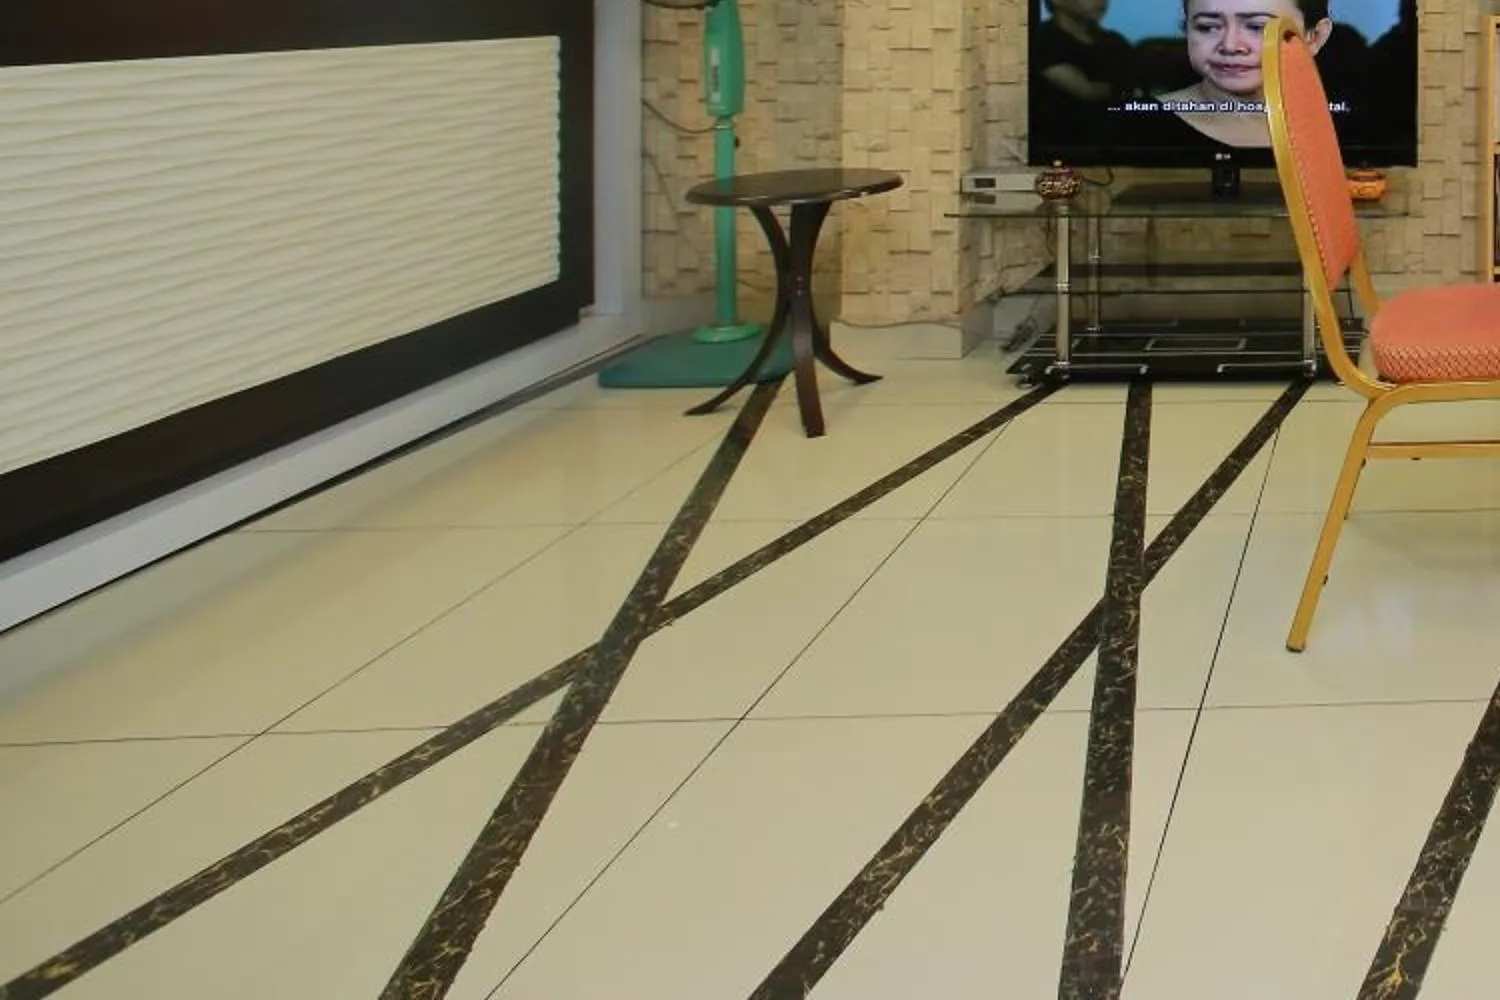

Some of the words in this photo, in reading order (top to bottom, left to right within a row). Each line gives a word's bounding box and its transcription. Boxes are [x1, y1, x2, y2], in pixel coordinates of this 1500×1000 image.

[1124, 100, 1159, 111] akan
[1163, 100, 1215, 111] ditahan
[1219, 100, 1233, 111] di
